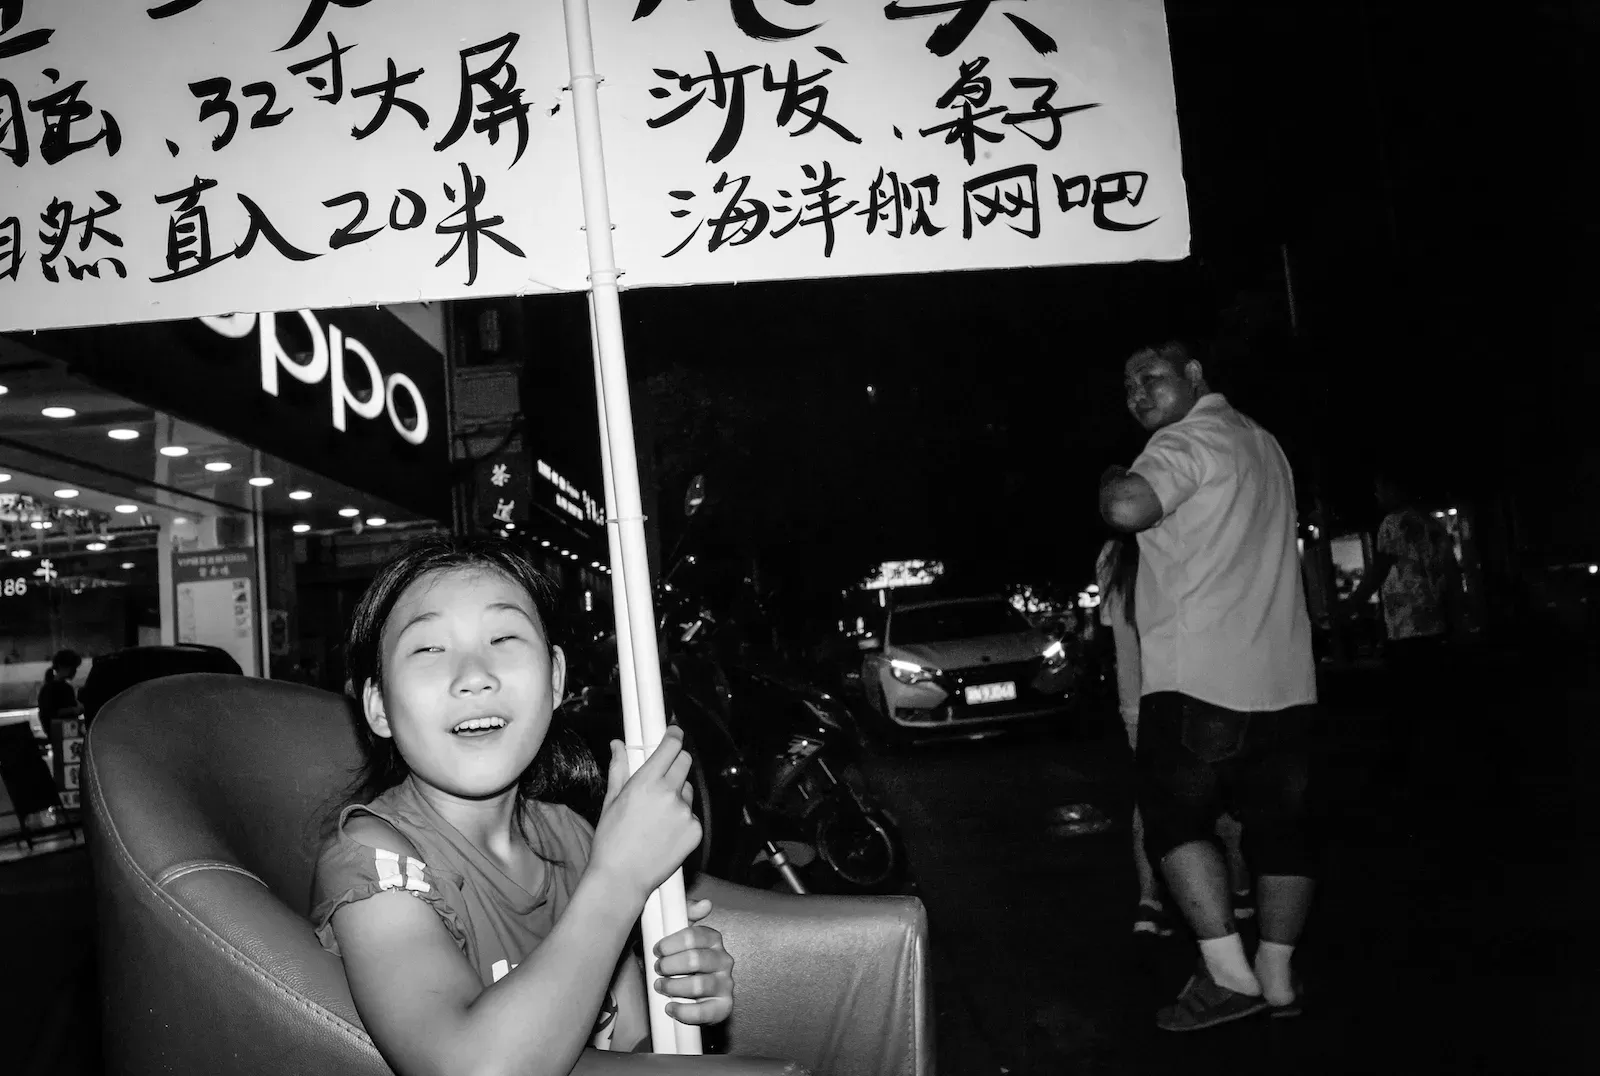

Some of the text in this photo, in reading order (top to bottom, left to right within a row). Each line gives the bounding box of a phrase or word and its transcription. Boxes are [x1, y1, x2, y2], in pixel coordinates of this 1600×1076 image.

[662, 161, 1159, 257] 海洋舰网吧
